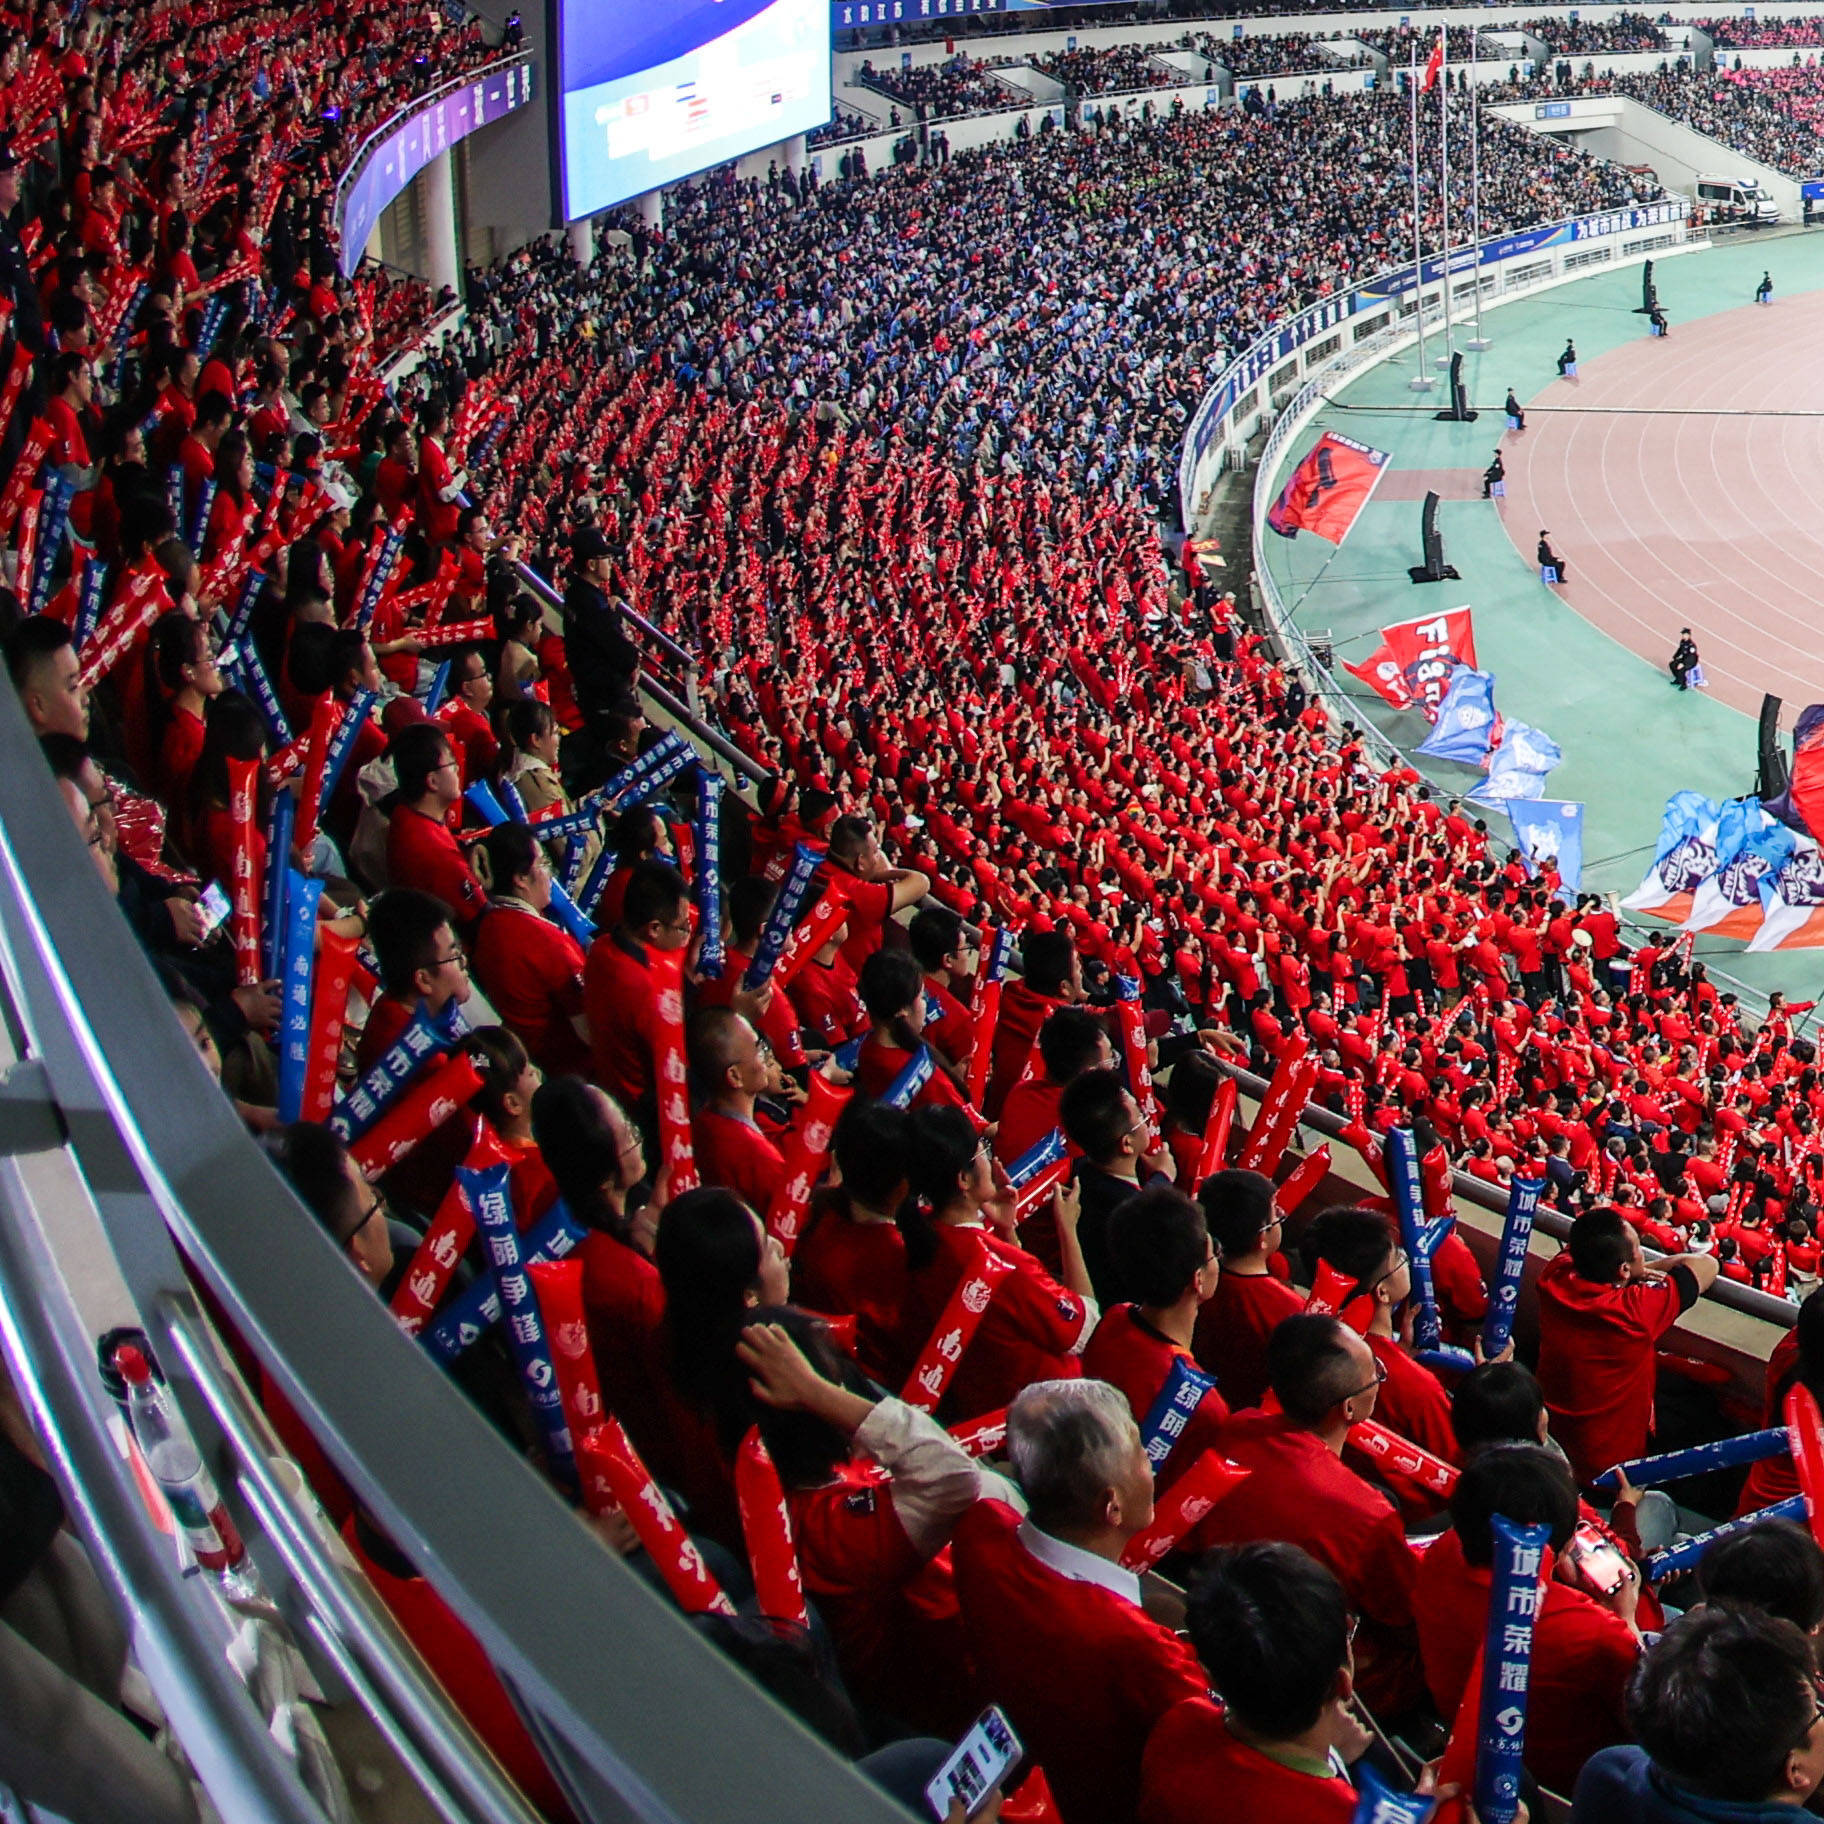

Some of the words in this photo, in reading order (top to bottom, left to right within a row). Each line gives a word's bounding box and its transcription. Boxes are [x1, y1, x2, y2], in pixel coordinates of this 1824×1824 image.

[844, 1, 902, 24] 水韵江苏
[1577, 211, 1632, 240] 为城市而战
[291, 954, 311, 1063] 南通必胜
[478, 1190, 542, 1345] 绿茵争锋
[1502, 1189, 1537, 1277] 城市荣耀
[1499, 1543, 1544, 1691] 城市荣耀
